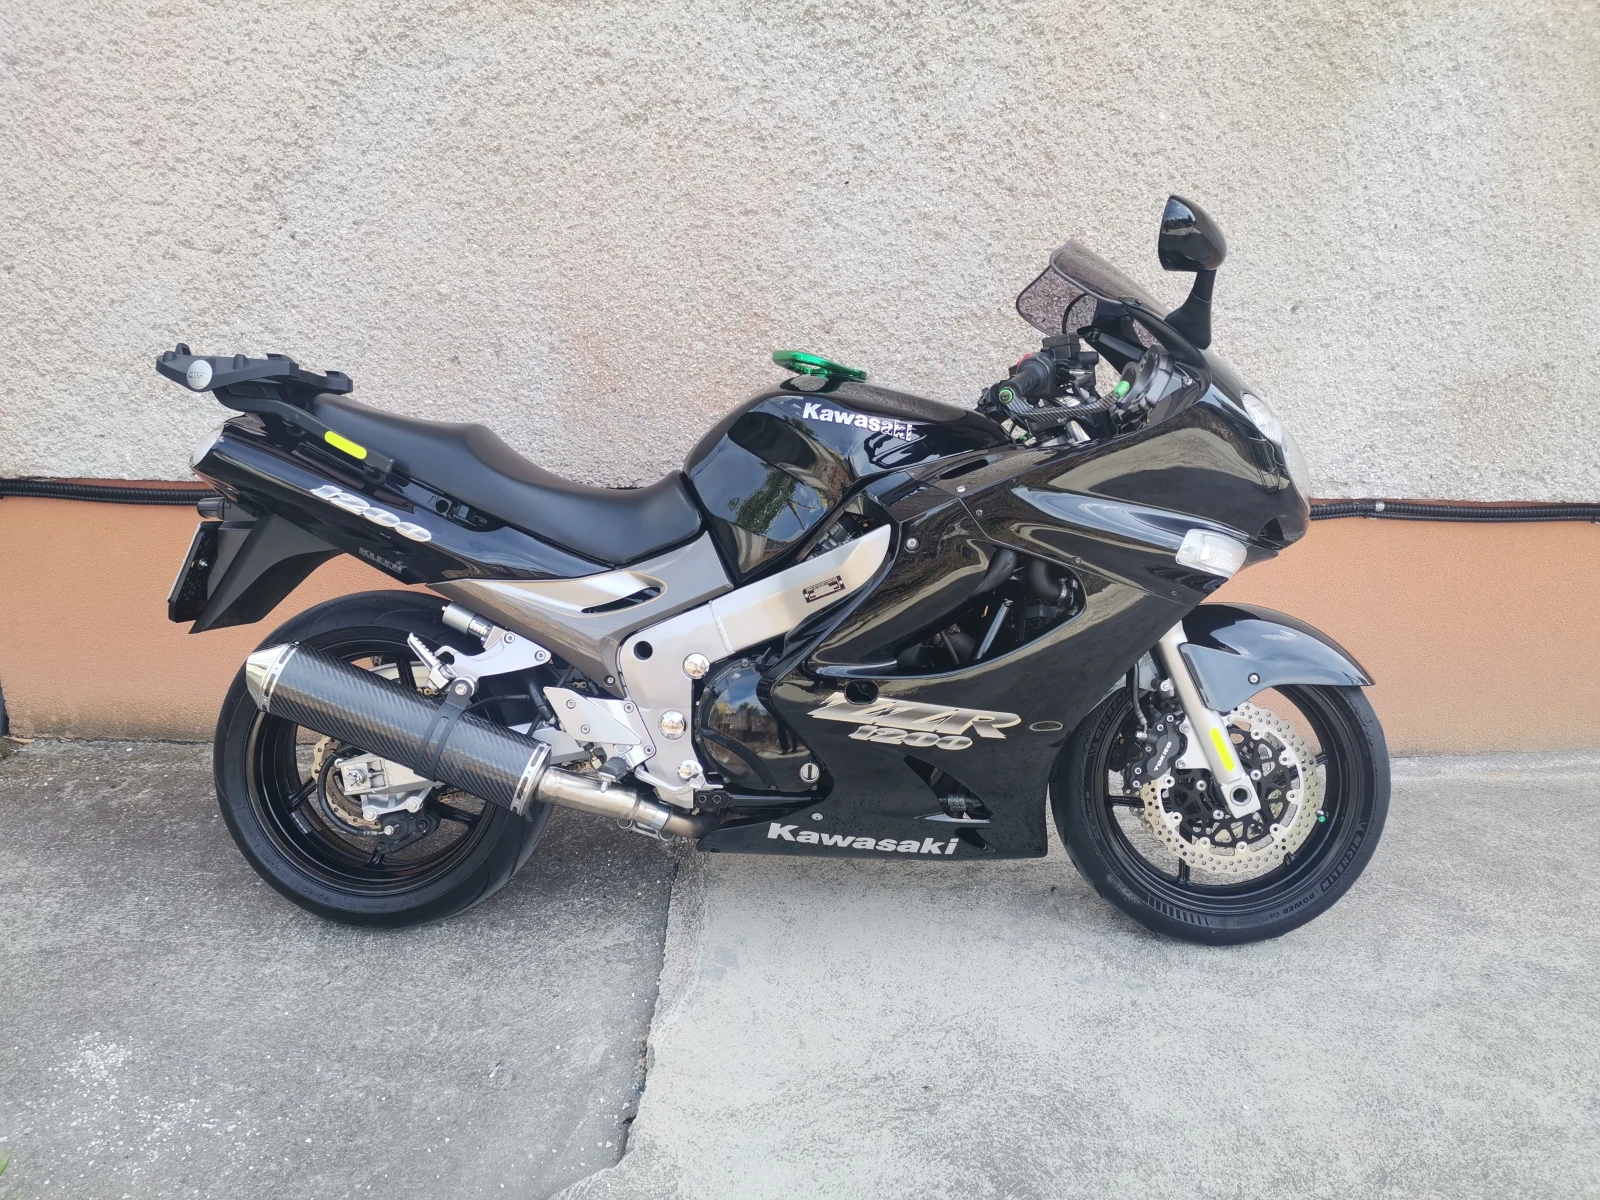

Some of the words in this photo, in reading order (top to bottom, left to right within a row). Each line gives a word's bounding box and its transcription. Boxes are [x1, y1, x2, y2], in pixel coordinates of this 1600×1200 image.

[802, 402, 913, 442] Kawasaki
[310, 484, 432, 542] 1200
[848, 724, 973, 750] 1200
[1153, 741, 1172, 771] TOKICO
[767, 822, 959, 855] Kawasaki
[1320, 829, 1363, 892] MICHELIN
[1283, 892, 1315, 915] POWER
